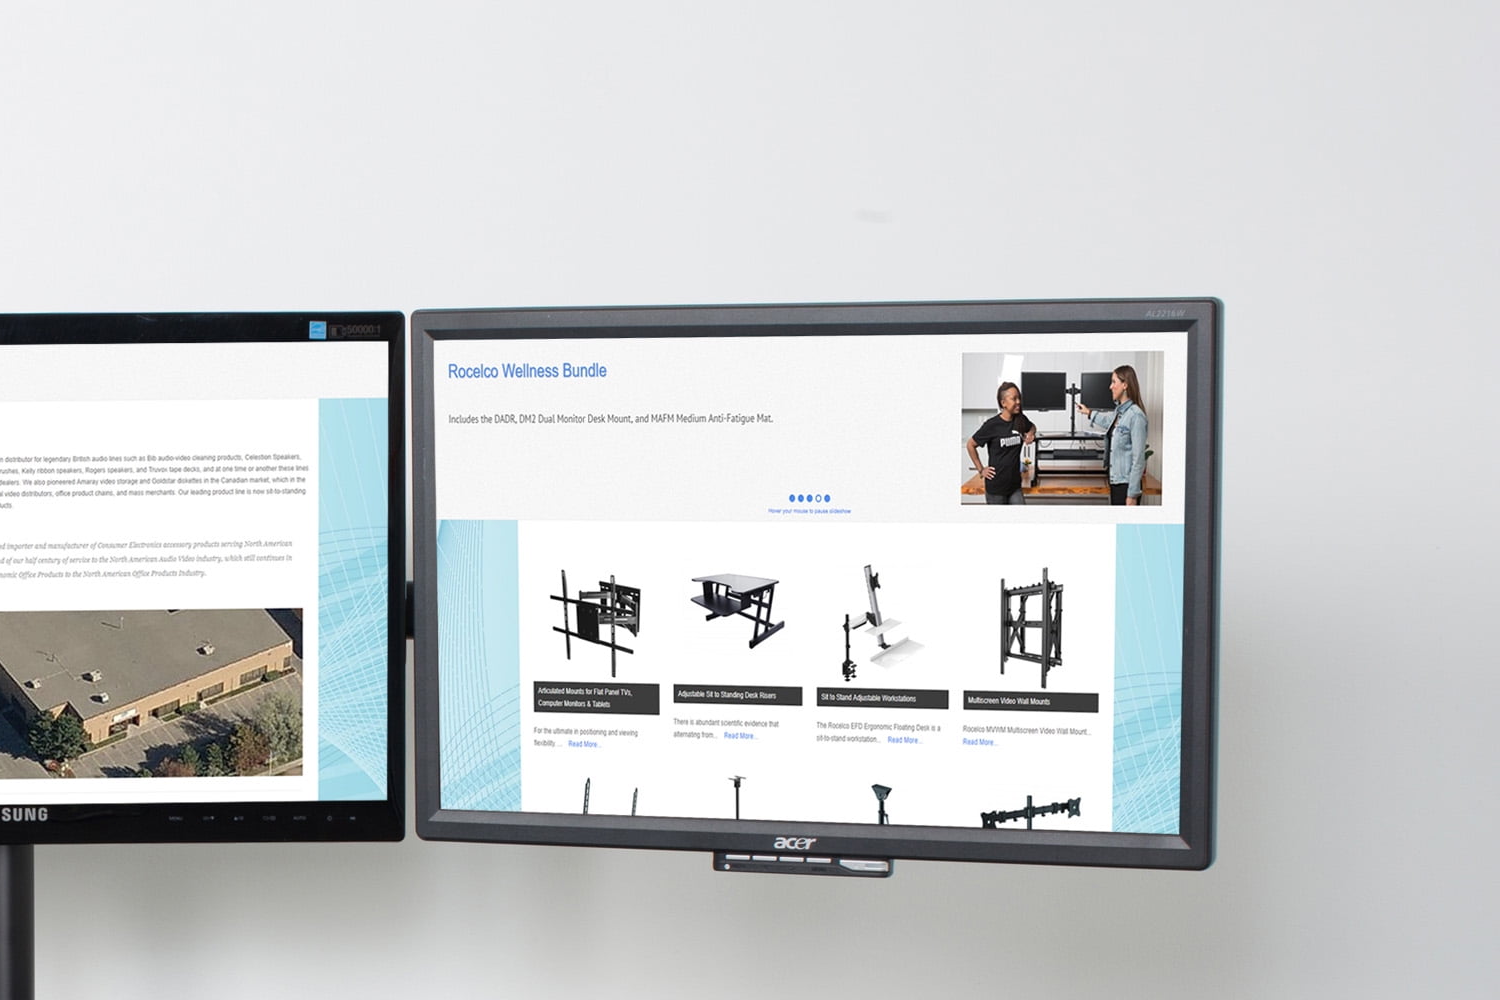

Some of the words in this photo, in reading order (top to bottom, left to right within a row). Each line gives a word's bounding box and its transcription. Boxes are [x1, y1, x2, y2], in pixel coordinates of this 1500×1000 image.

[448, 364, 498, 378] Rocelco
[502, 363, 559, 378] Wellness
[563, 363, 607, 378] Bundle
[449, 415, 479, 424] Includes
[481, 415, 492, 424] the
[494, 414, 517, 424] DADR,
[519, 414, 536, 423] DM2
[538, 414, 555, 423] Dual
[557, 414, 585, 423] Monitor
[588, 414, 605, 423] Desk
[607, 414, 633, 424] Mount,
[635, 414, 649, 423] and
[651, 413, 674, 423] MAFM
[676, 414, 706, 423] Medium
[708, 413, 754, 425] Anti-Fatigue
[757, 414, 773, 423] Mat.
[774, 837, 816, 850] acer
